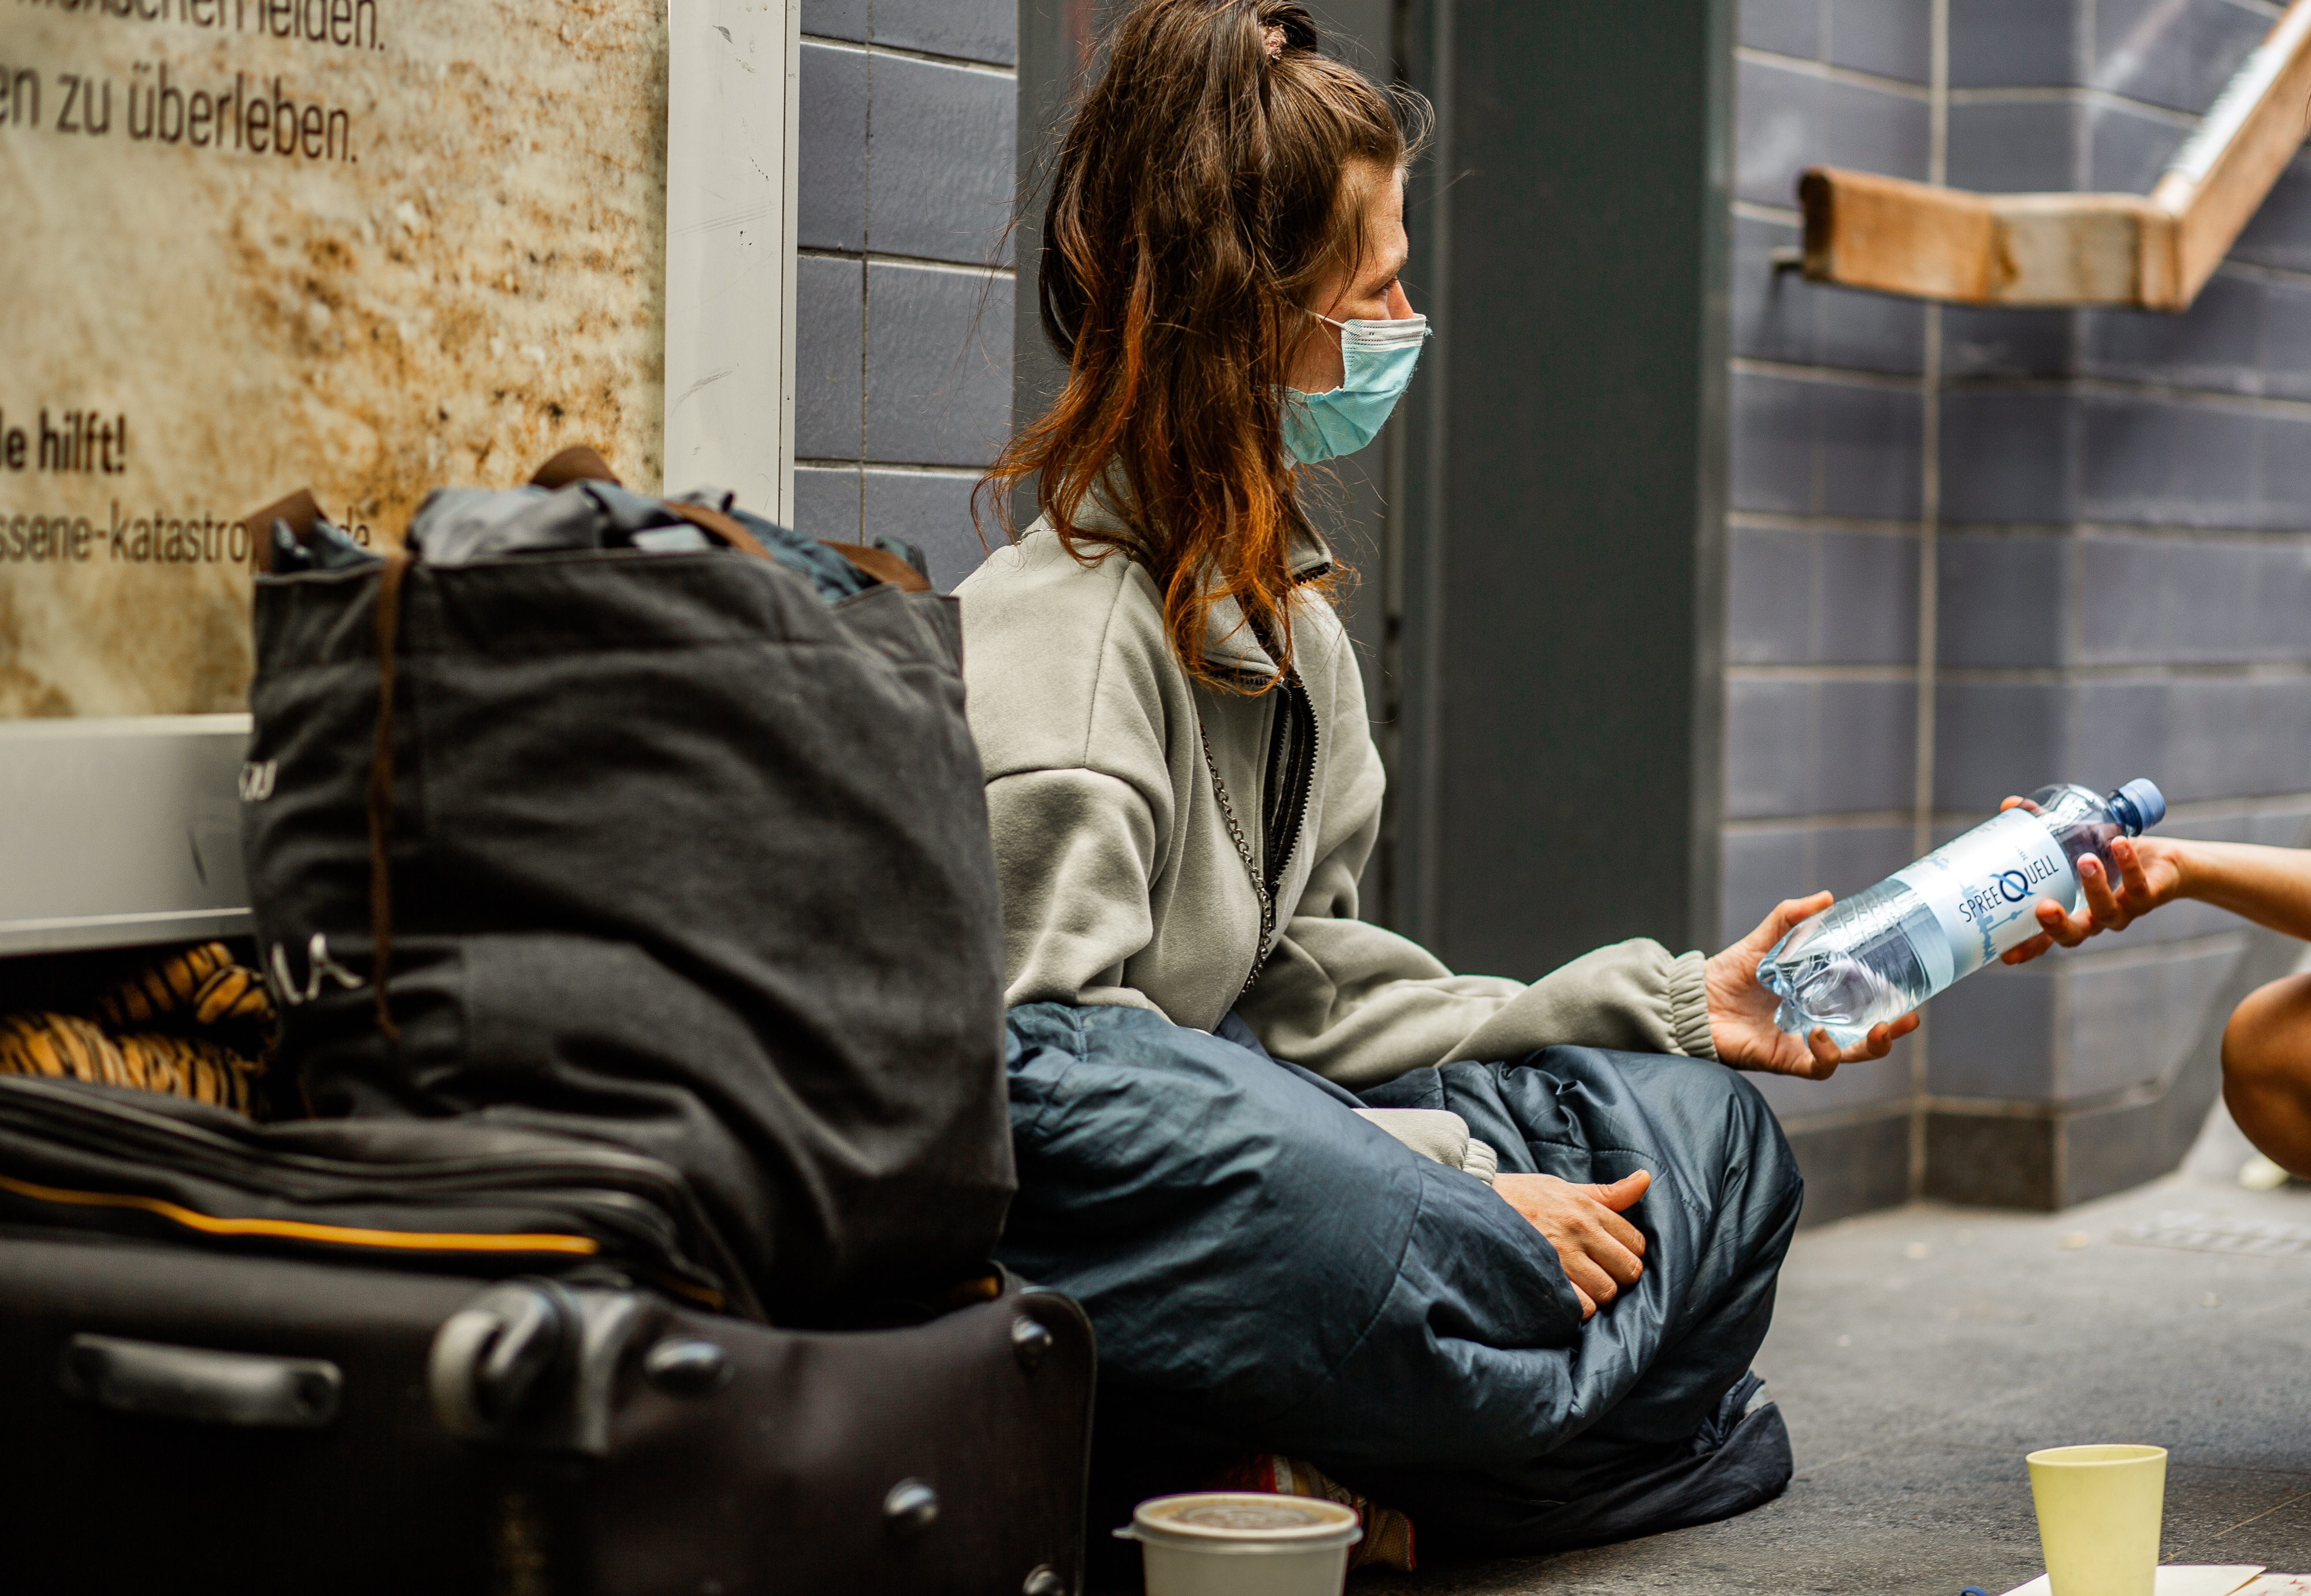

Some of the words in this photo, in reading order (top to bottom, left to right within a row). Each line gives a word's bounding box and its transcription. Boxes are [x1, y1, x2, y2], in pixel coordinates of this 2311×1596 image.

[58, 73, 111, 135] zu
[128, 61, 358, 164] überleben.
[39, 408, 125, 474] hilft!
[1959, 855, 2059, 922] SPREEQUELL
